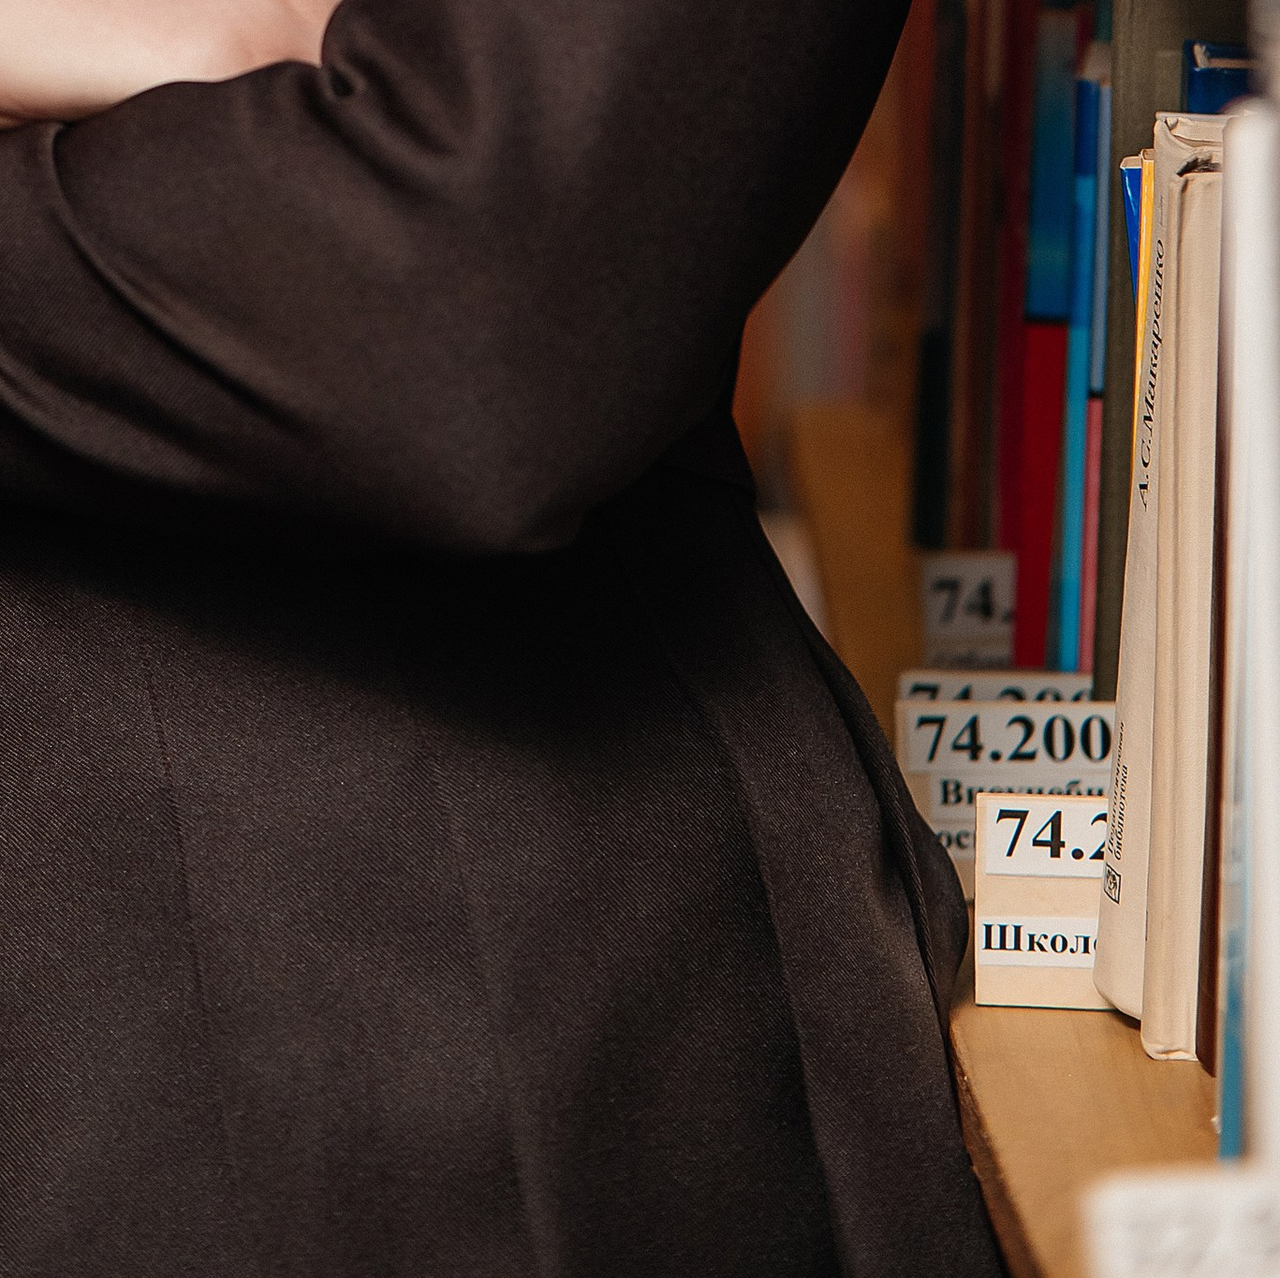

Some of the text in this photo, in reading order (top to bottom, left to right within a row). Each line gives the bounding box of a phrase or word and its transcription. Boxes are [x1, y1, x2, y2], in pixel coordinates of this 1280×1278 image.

[915, 714, 1113, 763] 74.200
[1114, 764, 1130, 861] библиотека
[982, 922, 1099, 955] Школ
